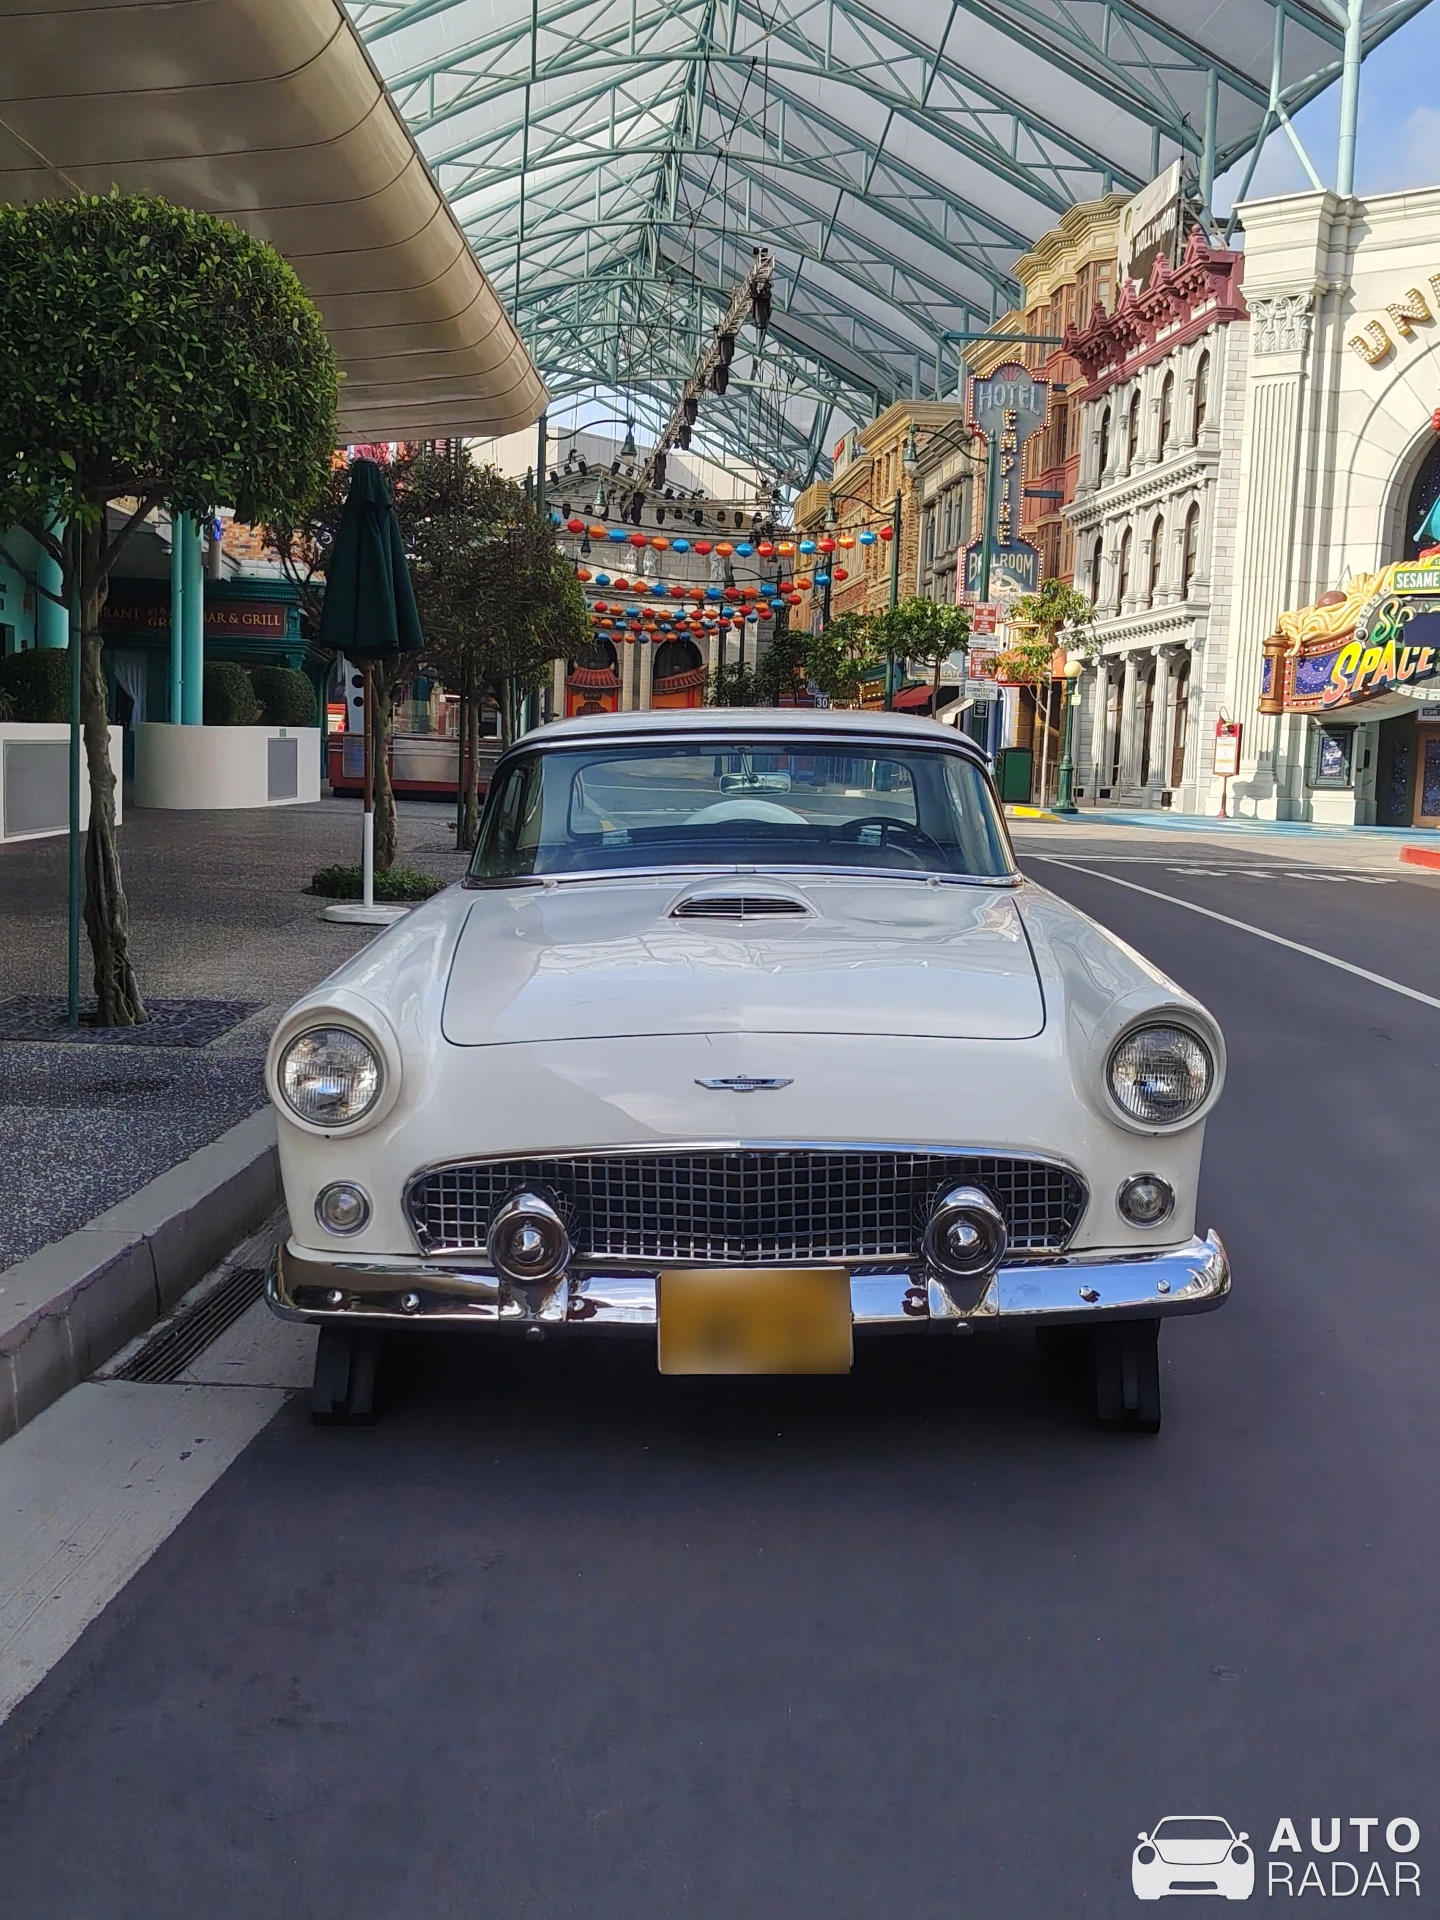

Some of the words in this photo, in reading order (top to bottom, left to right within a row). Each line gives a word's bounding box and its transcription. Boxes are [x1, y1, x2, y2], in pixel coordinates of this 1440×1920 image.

[1135, 207, 1175, 258] HOLLYWOOD
[978, 383, 1040, 416] HOTEL
[997, 408, 1017, 546] EMPIRE
[1396, 572, 1440, 589] SESAME
[228, 613, 239, 624] &
[242, 613, 281, 626] GRILL
[1322, 639, 1436, 706] SPACE
[816, 698, 828, 708] 30
